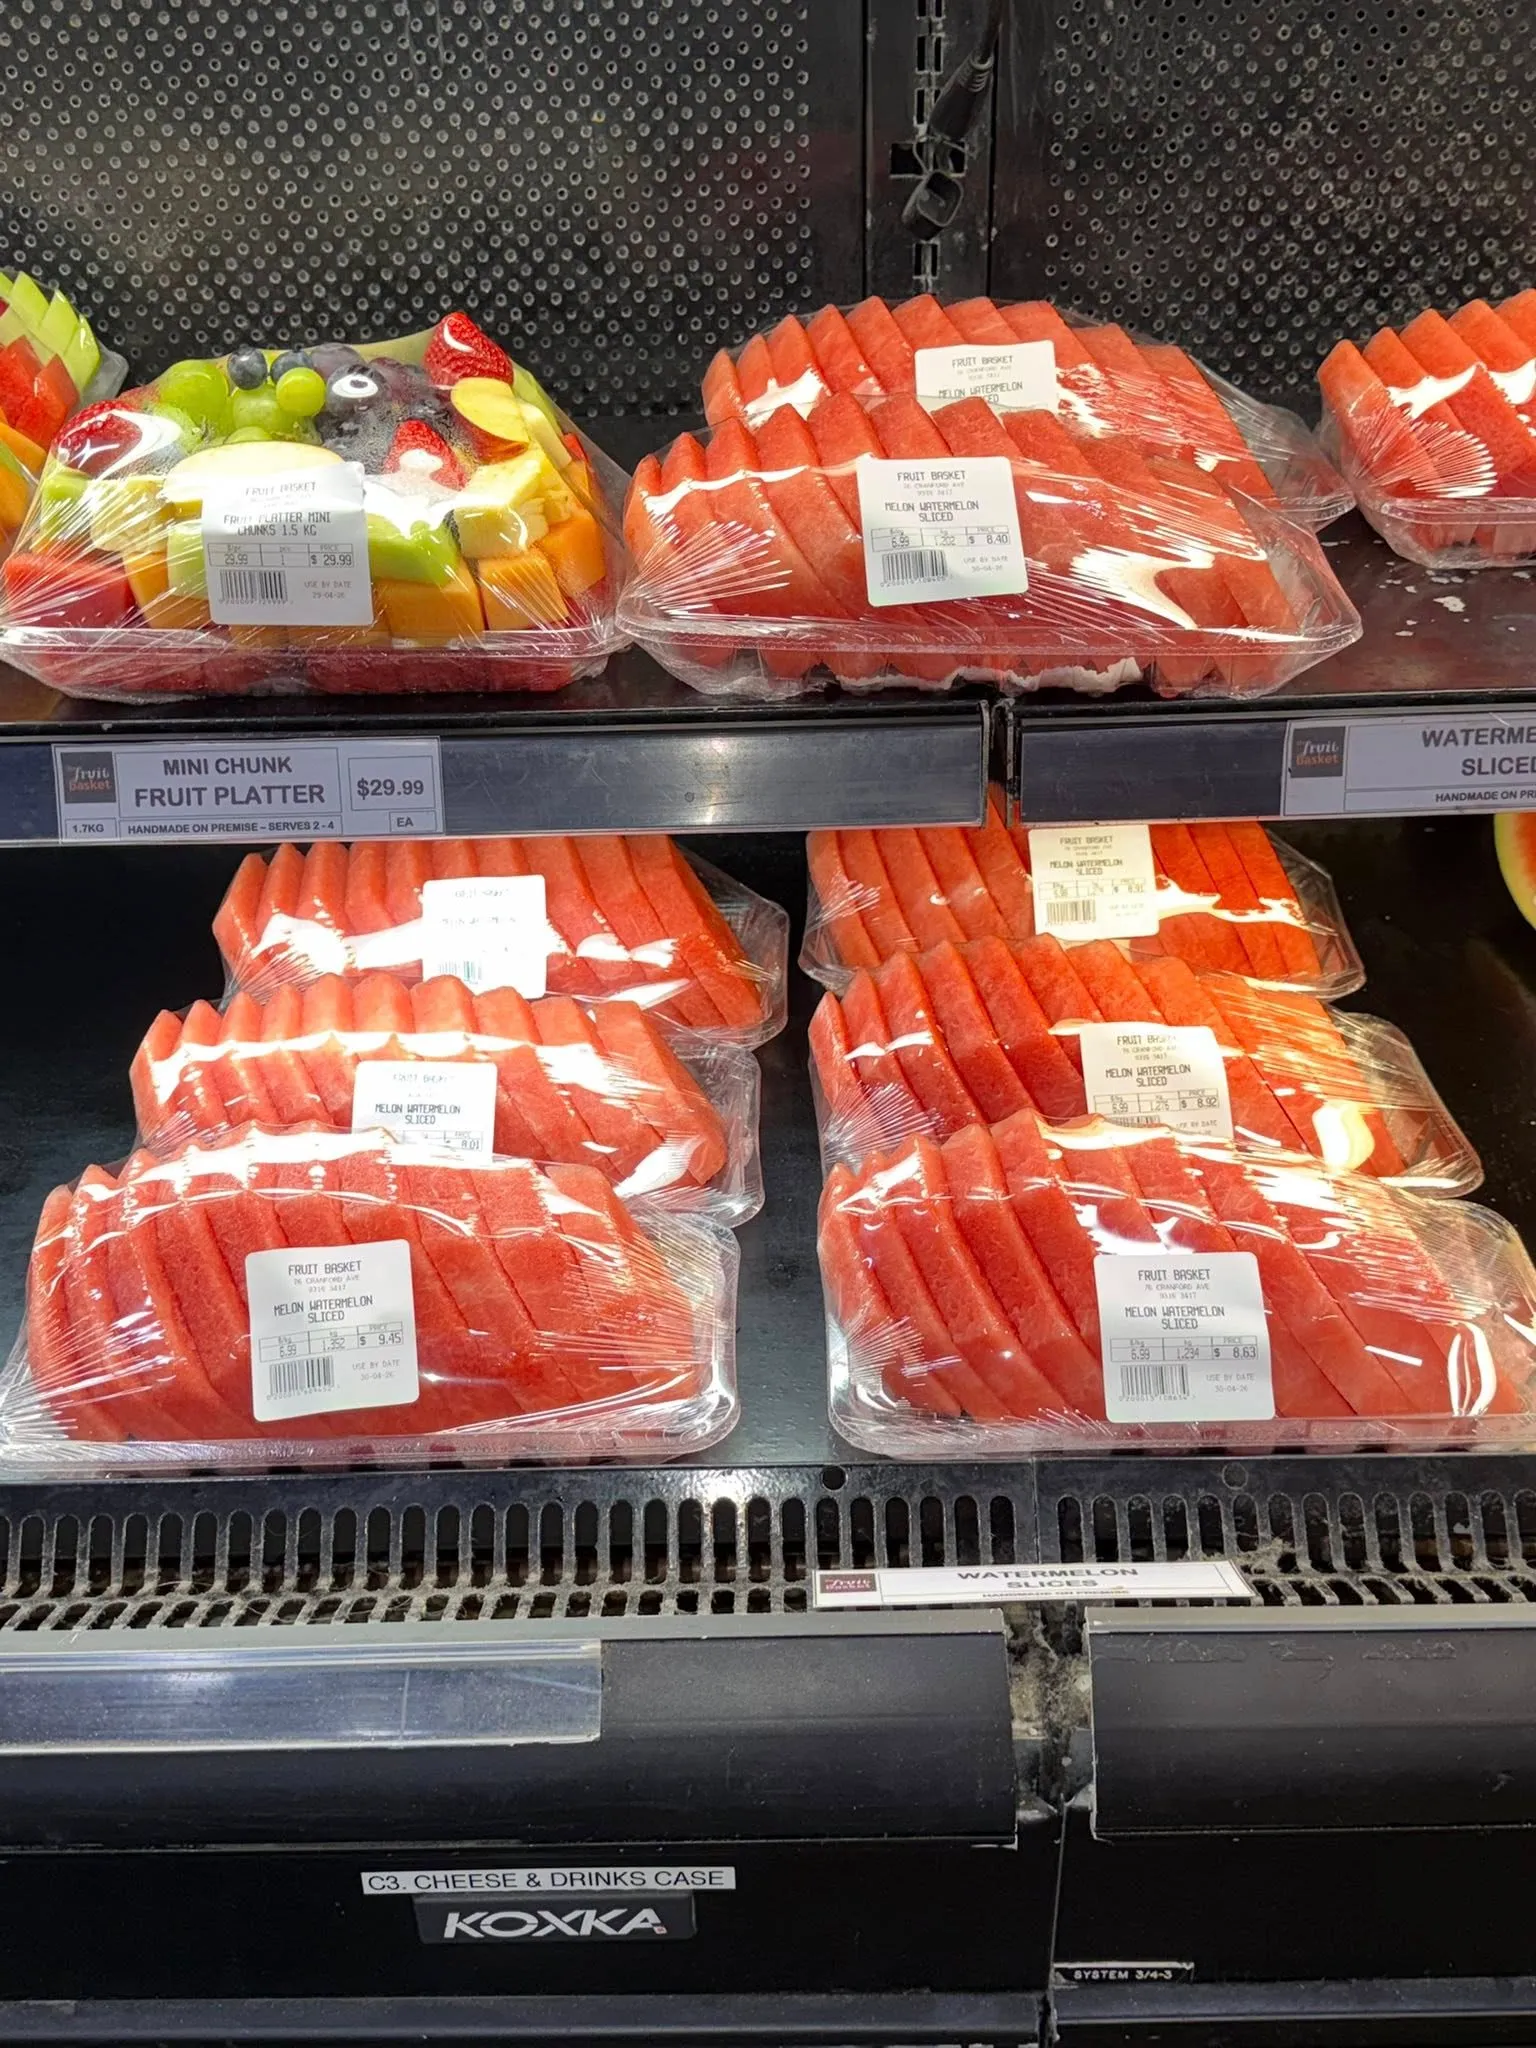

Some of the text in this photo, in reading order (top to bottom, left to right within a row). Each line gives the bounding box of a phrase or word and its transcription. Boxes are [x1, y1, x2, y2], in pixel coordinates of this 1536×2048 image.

[952, 355, 1013, 368] FRUIT BASKET
[939, 381, 1023, 399] MELON WATERMELON
[897, 470, 966, 481] FRUIT BASKET
[885, 501, 979, 511] MELON WATERMELON
[259, 512, 302, 524] PLATTER
[308, 512, 331, 522] MINI
[919, 512, 953, 522] SLICED
[237, 524, 317, 536] CHUNKS 1.5 KG
[969, 535, 1008, 544] $ 8.40
[224, 554, 248, 565] 29.99
[311, 554, 352, 566] $ 29.99
[163, 756, 293, 775] MINI CHUNK
[356, 777, 425, 801] $29.99
[135, 784, 325, 808] FRUIT PLATTER
[1435, 791, 1499, 802] HANDMADE
[1500, 790, 1517, 800] ON
[128, 823, 191, 835] HANDMADE
[192, 823, 208, 833] ON
[211, 822, 258, 833] PREMISE
[268, 820, 311, 831] SERVES
[313, 820, 320, 830] 2
[327, 820, 335, 830] 4
[396, 816, 415, 828] EA
[72, 823, 105, 834] 1.7KG
[1050, 859, 1123, 869] MELON WATERMELON
[1117, 1035, 1142, 1046] FRUIT
[1106, 1064, 1191, 1078] MELON WATERMELON
[1136, 1076, 1167, 1087] SLICED
[375, 1104, 460, 1114] MELON WATERMELON
[1181, 1097, 1217, 1109] $ 8.92
[405, 1115, 436, 1124] SLICED
[288, 1261, 362, 1276] FRUIT BASKET
[1138, 1269, 1211, 1281] FRUIT BASKET
[274, 1295, 373, 1317] MELON WATERMELON
[1125, 1306, 1225, 1318] MELON WATERMELON
[308, 1310, 345, 1323] SLICED
[1161, 1318, 1198, 1330] SLICED
[322, 1338, 345, 1351] 1.352
[359, 1332, 401, 1345] $ 9.45
[280, 1345, 297, 1358] 6.99
[1131, 1348, 1150, 1360] 6.99
[1176, 1347, 1200, 1359] 1.234
[1214, 1346, 1256, 1358] $ 8.63
[352, 1363, 365, 1371] USE
[382, 1359, 400, 1367] DATE
[1236, 1373, 1255, 1381] DATE
[957, 1569, 1138, 1580] WATERMELON
[1007, 1579, 1098, 1588] SLICES
[368, 1870, 725, 1891] C3. CHEESE & DRINKS CASE
[443, 1908, 663, 1938] KOXKA
[1074, 1969, 1129, 1980] SYSTEM
